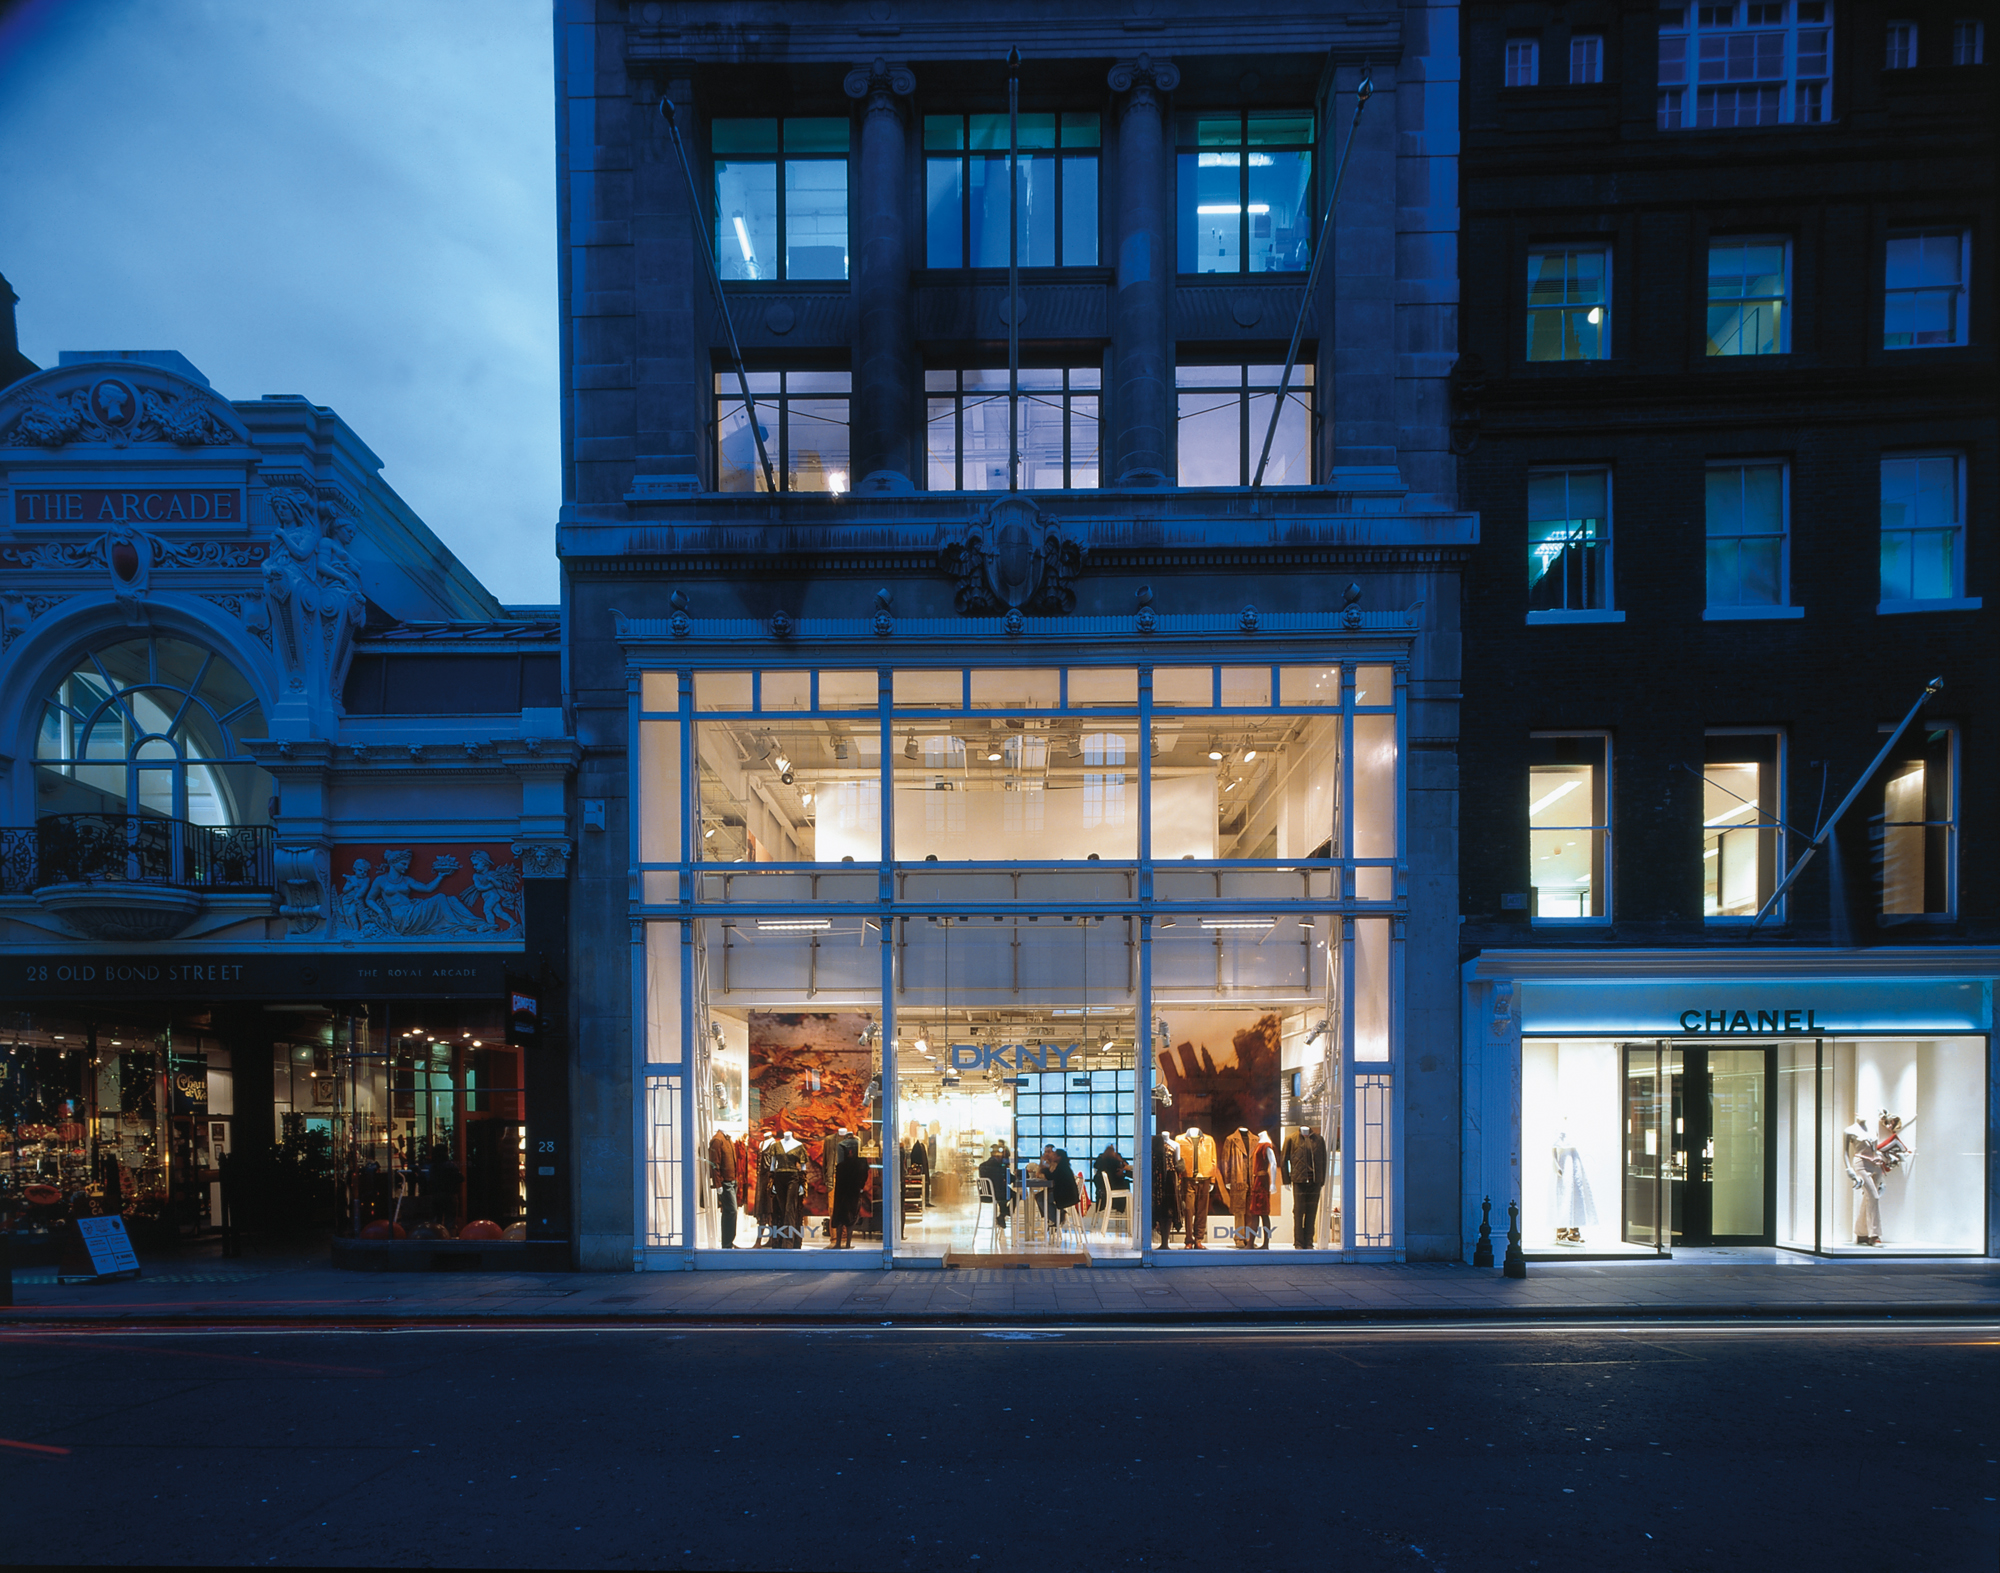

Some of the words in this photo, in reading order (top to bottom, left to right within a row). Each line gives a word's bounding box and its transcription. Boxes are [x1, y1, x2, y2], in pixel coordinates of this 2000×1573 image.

[21, 493, 84, 521] THE
[97, 493, 233, 521] ARCADE
[26, 965, 48, 981] 28
[57, 965, 96, 981] OLD
[105, 965, 160, 981] BOND
[169, 964, 244, 981] STREET
[357, 968, 378, 977] THE
[387, 968, 422, 977] ROYAL
[432, 968, 477, 977] ARCADE
[1680, 1009, 1825, 1032] CHANEL
[952, 1044, 1080, 1069] DKNY
[538, 1141, 555, 1153] 28
[758, 1225, 820, 1239] DKNY
[1213, 1225, 1278, 1239] DKNY
